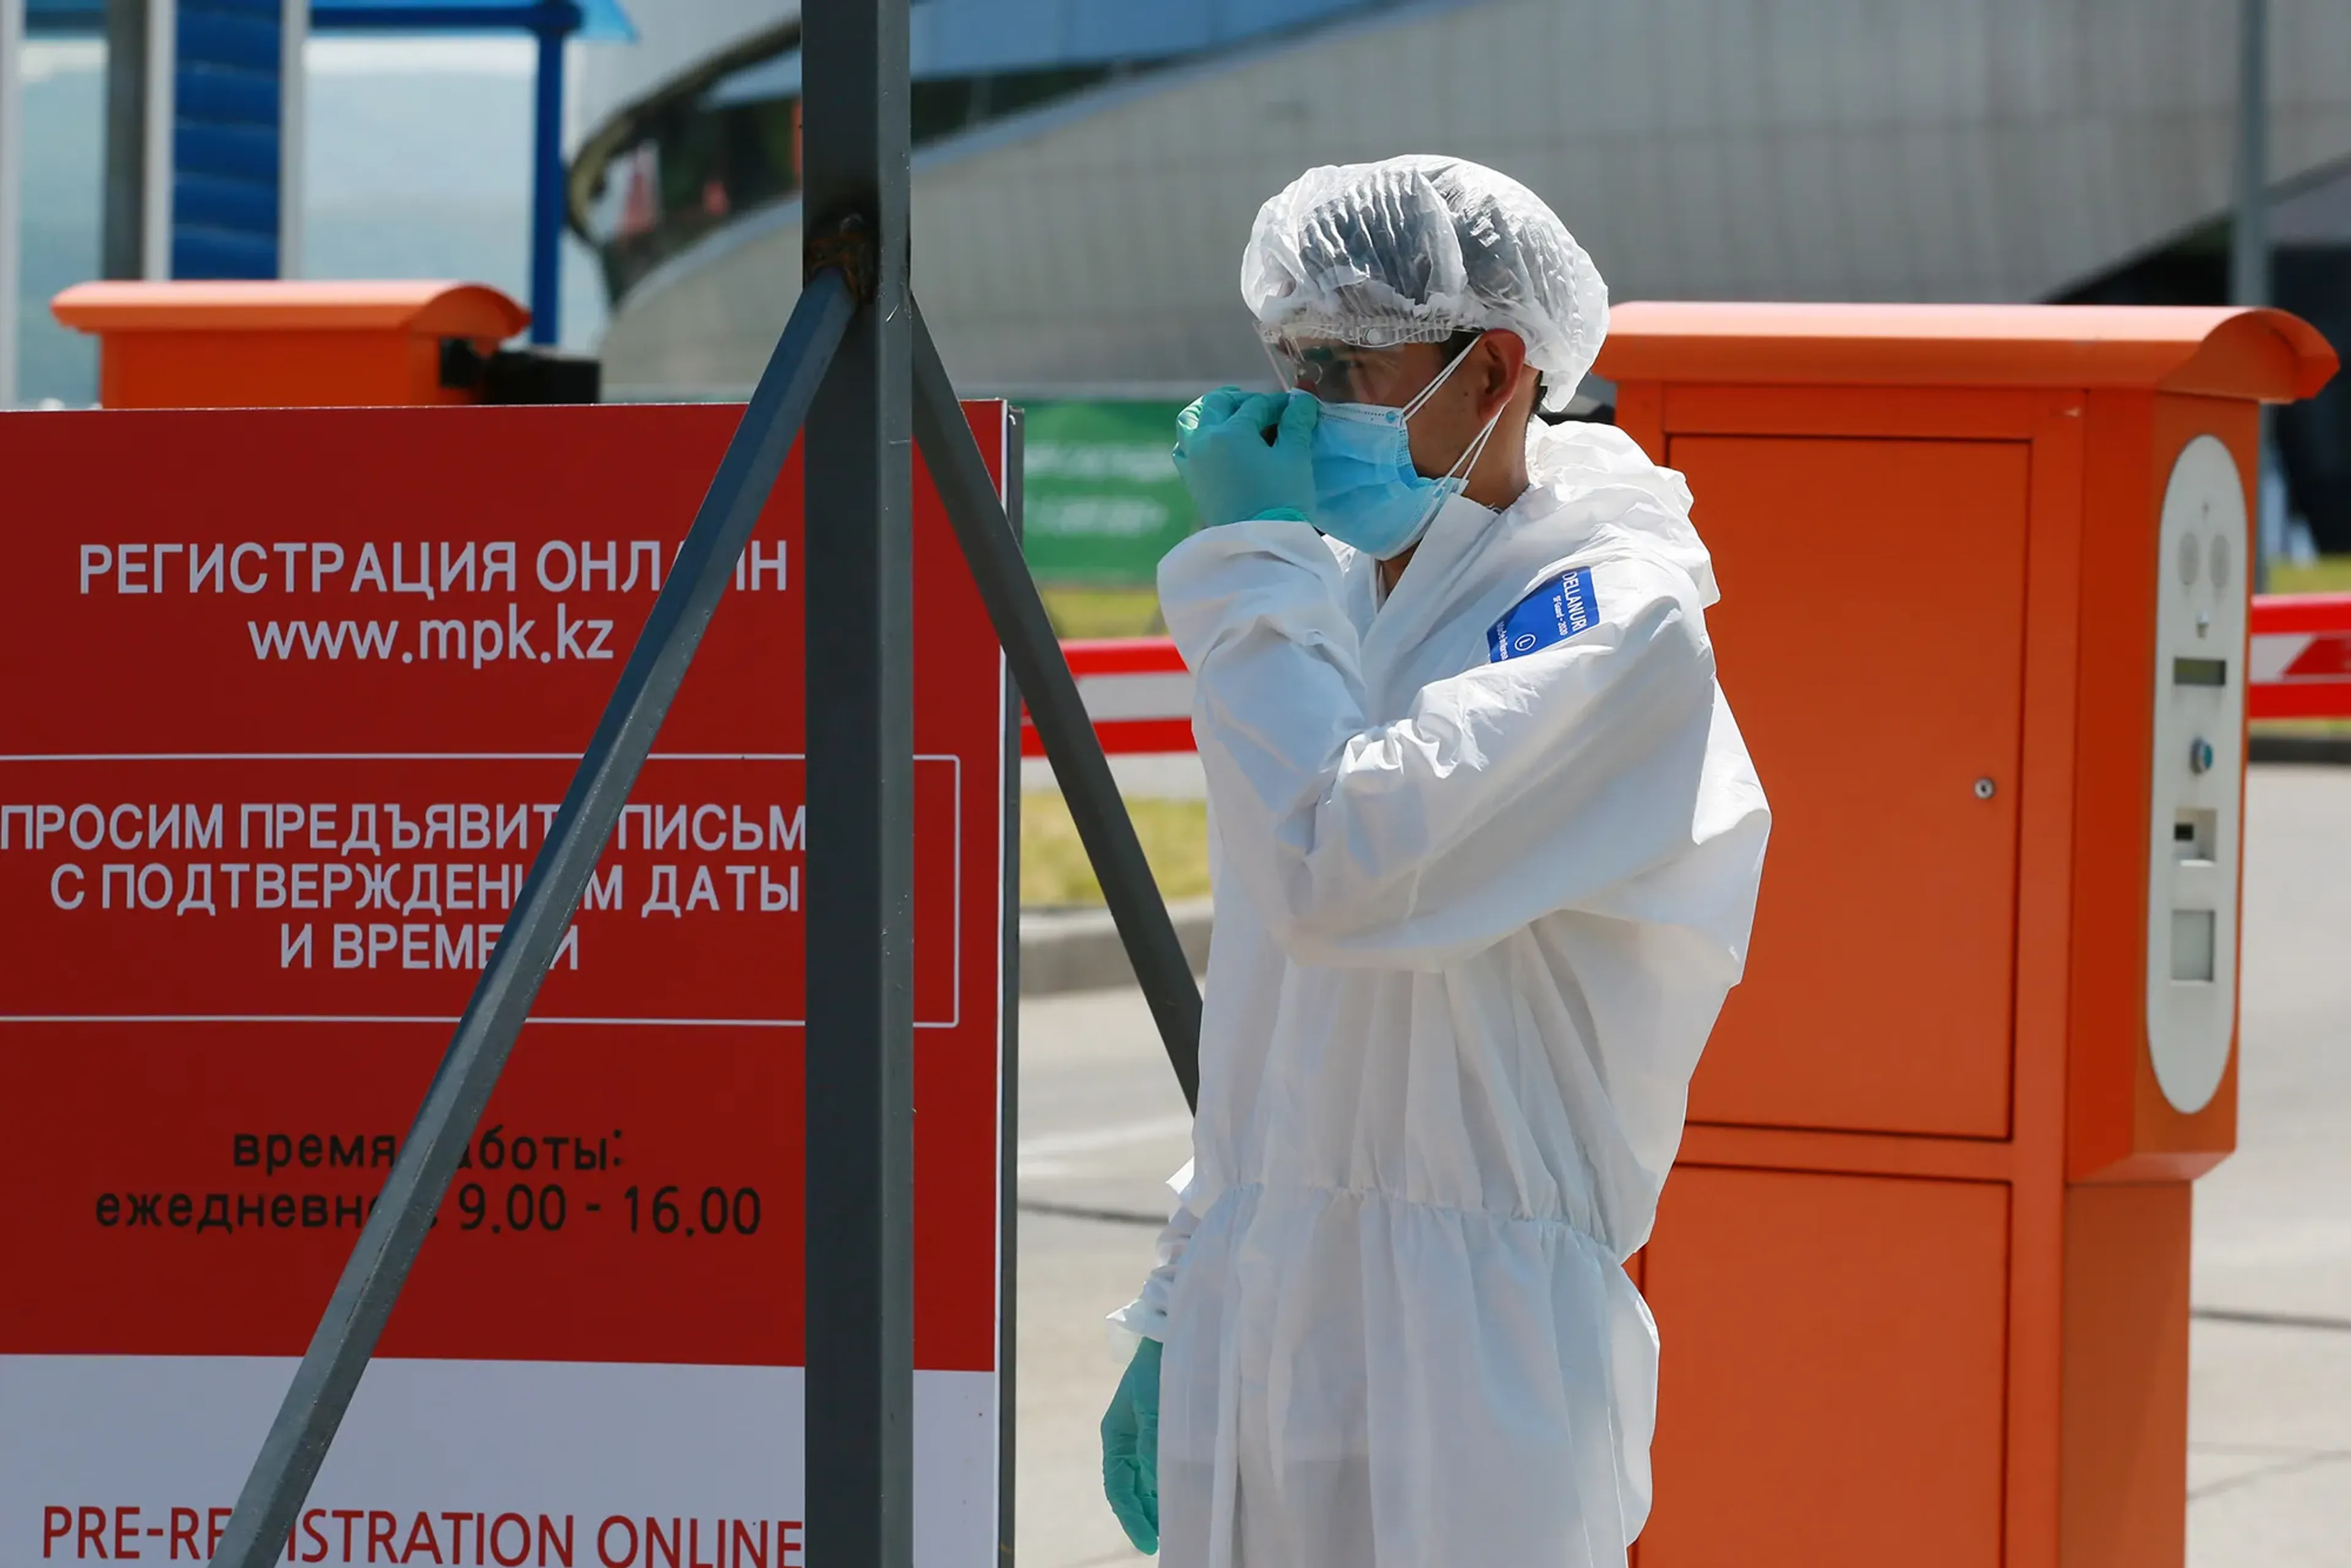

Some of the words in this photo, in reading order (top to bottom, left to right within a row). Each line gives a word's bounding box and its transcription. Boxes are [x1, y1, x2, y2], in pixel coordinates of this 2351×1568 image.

[80, 541, 516, 601] РЕГИСТРАЦИЯ
[536, 540, 787, 593] ОНЛН
[1562, 571, 1588, 632] DELLANURI
[247, 602, 613, 669] www.mpk.kz
[1, 803, 223, 850] ПРОСИМ
[241, 804, 561, 857] ПРЕДЪЯВИТ
[51, 863, 84, 910] С
[102, 863, 623, 917] ПОДТВЕРЖДЕНМ
[642, 865, 799, 918] ДАТЫ
[281, 923, 313, 969] И
[333, 923, 578, 970] ВРЕМЕИ
[233, 1133, 396, 1177] время
[457, 1123, 623, 1171] боты:
[96, 1192, 378, 1235] ежедневн
[459, 1182, 567, 1234] 9.00
[624, 1185, 761, 1237] 16.00
[43, 1506, 574, 1568] PRE-REISTRATION
[597, 1515, 803, 1568] ONLINE
